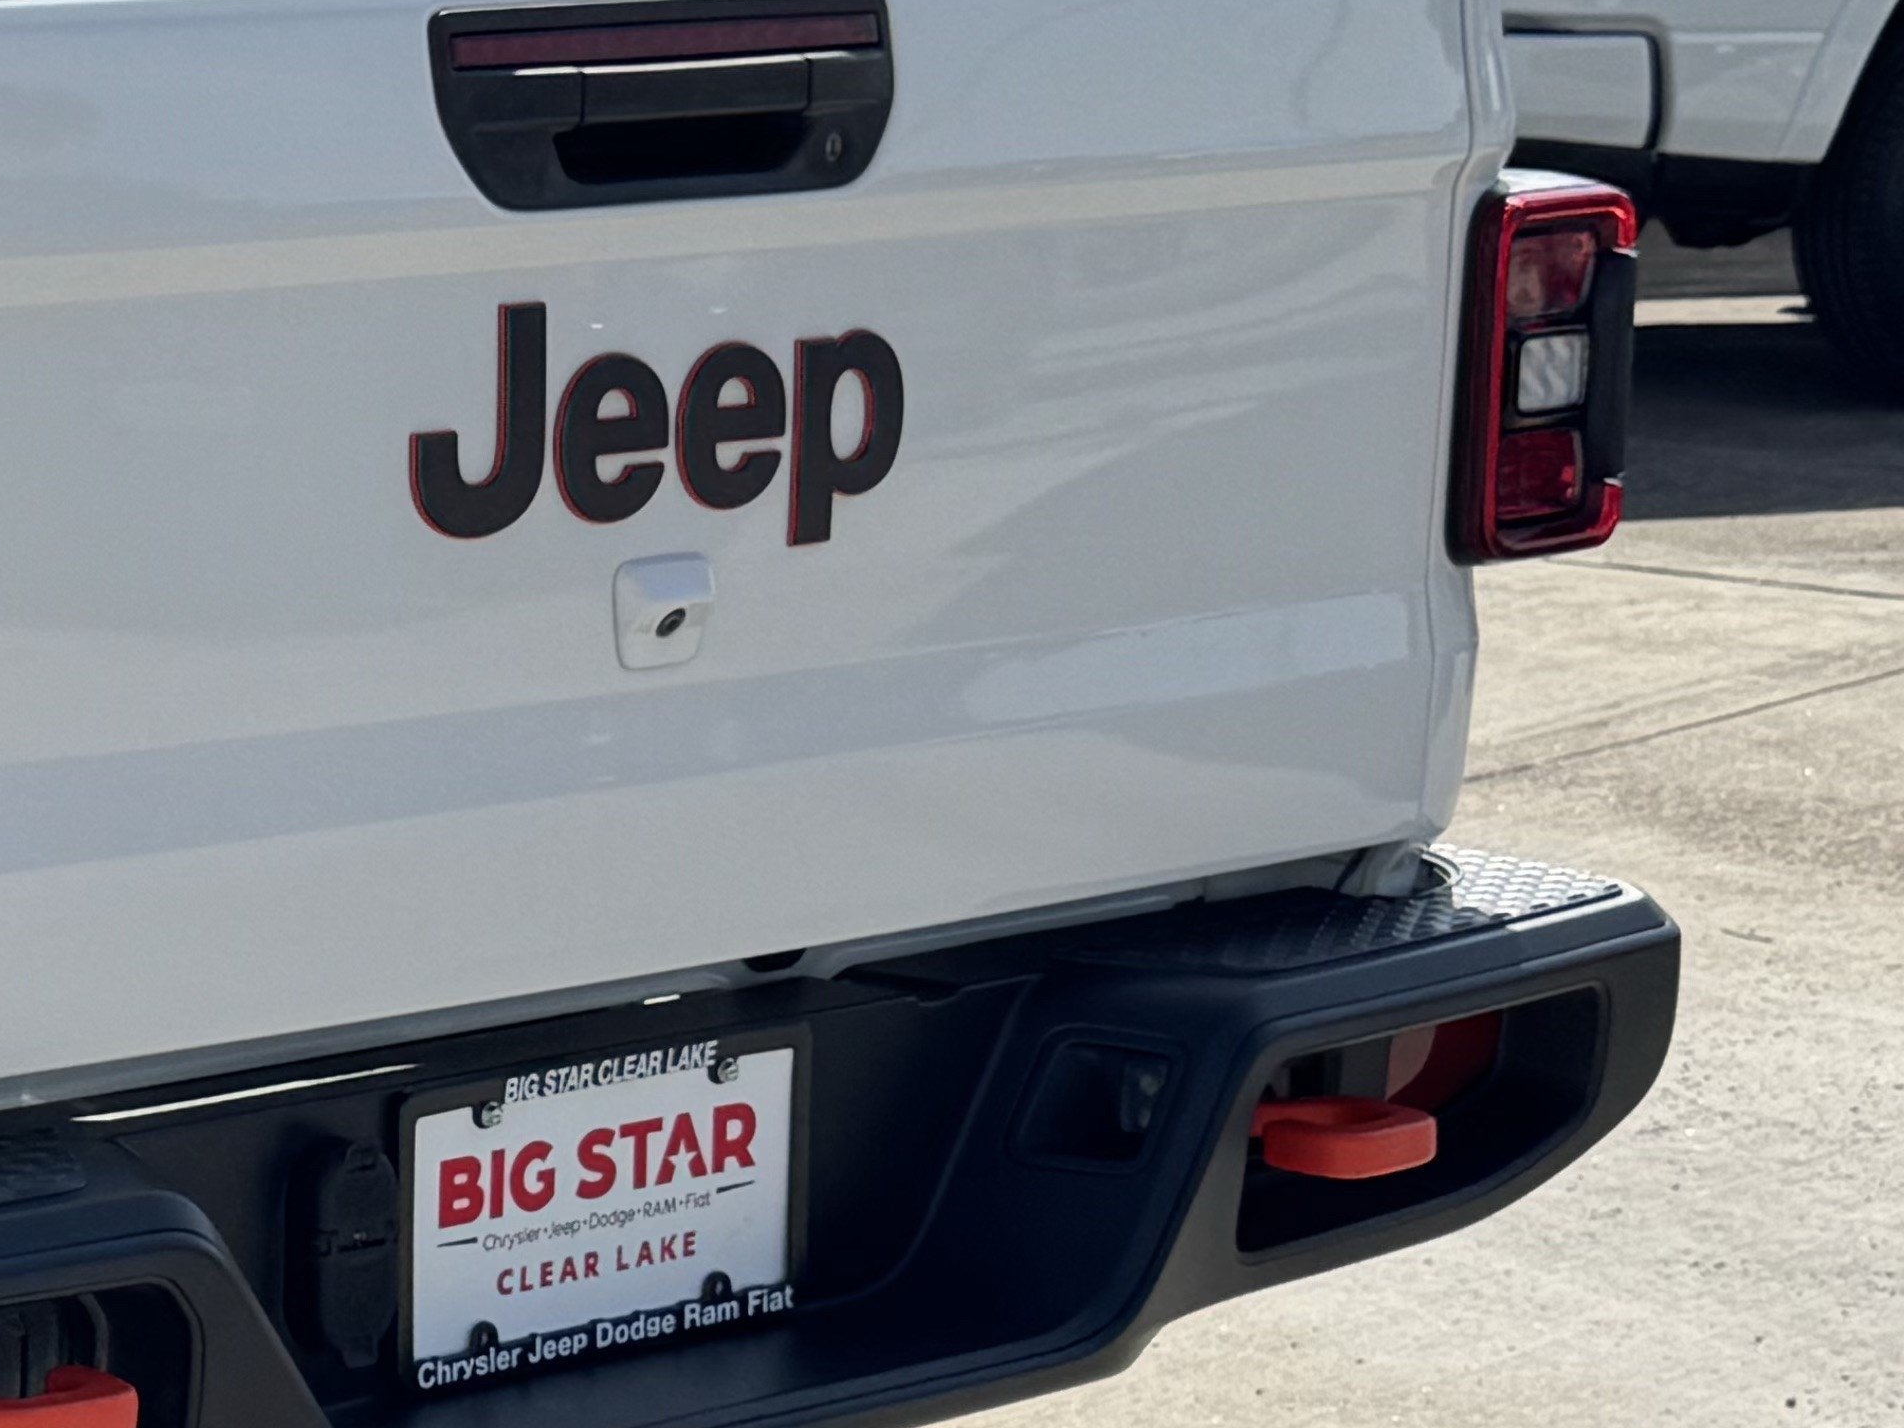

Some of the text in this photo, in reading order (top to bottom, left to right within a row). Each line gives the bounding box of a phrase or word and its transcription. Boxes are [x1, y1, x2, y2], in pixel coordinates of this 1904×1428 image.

[408, 301, 904, 547] Jeep
[504, 1039, 719, 1103] BIG STAR CLEAR LAKE
[438, 1102, 757, 1230] BIG STAR
[496, 1230, 698, 1296] CLEAR LAKE
[417, 1285, 794, 1390] Chrysler Jeep Dodge Ram Fiat
